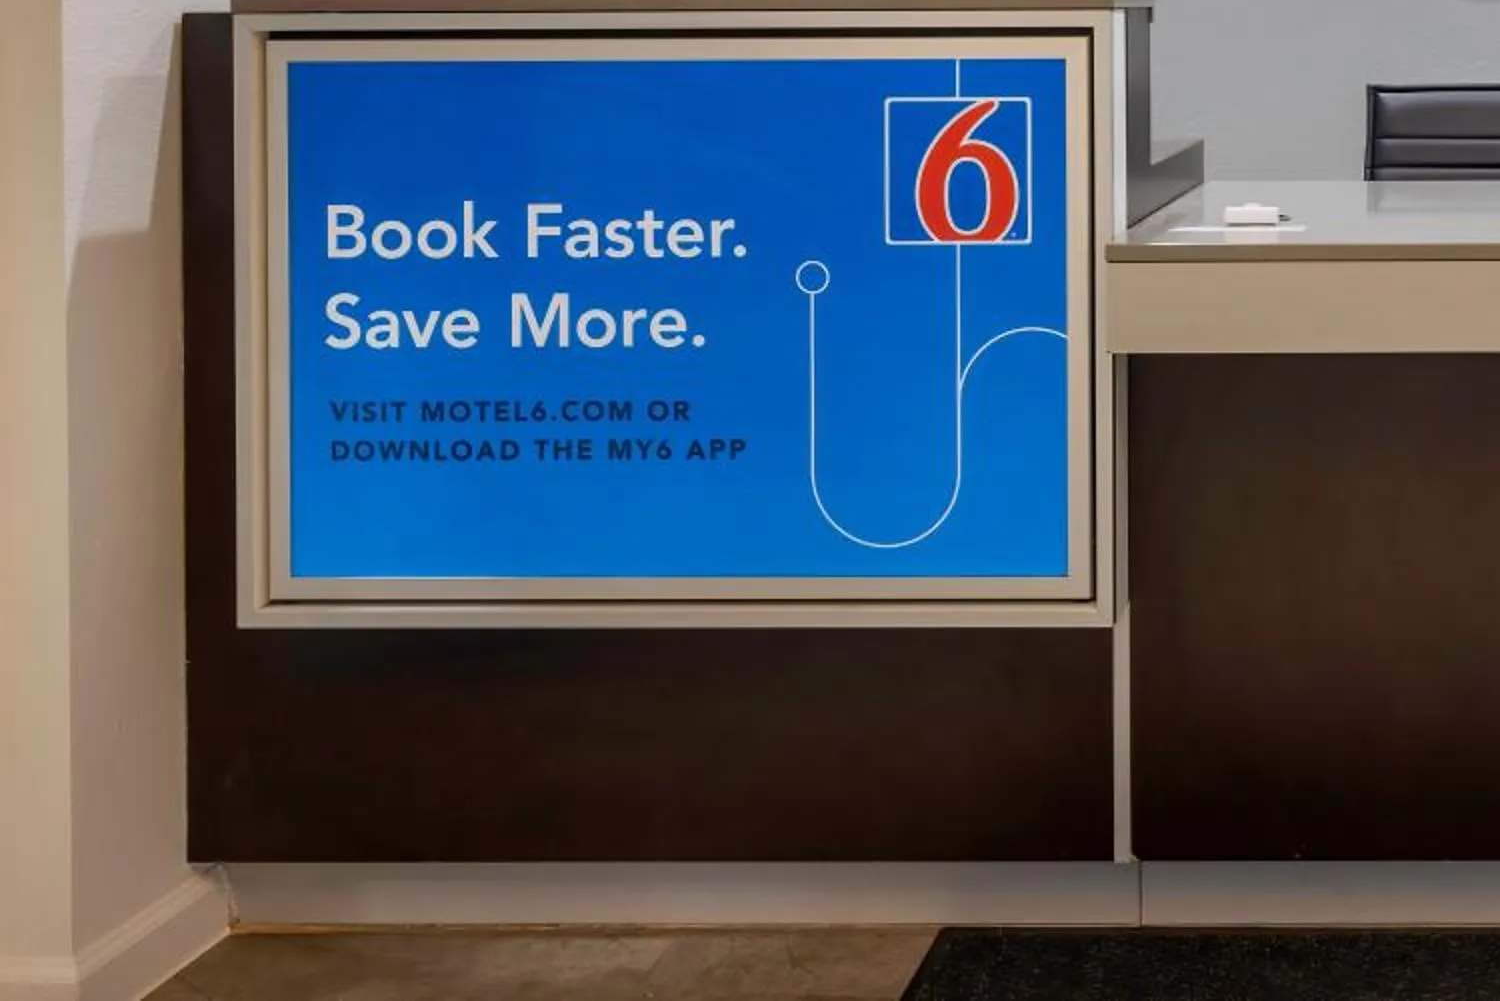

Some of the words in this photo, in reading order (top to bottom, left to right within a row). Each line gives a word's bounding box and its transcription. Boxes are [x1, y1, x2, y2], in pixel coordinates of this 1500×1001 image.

[914, 98, 1020, 244] 6
[326, 200, 500, 260] Book
[526, 202, 748, 259] Faster.
[324, 292, 481, 350] Save
[510, 292, 706, 349] More.
[330, 400, 408, 424] VISIT
[420, 399, 633, 424] MOTEL6.COM
[646, 400, 692, 424] OR
[331, 438, 521, 462] DOWNLOAD
[534, 439, 594, 461] THE
[607, 438, 673, 461] MY6
[686, 438, 748, 461] APP
